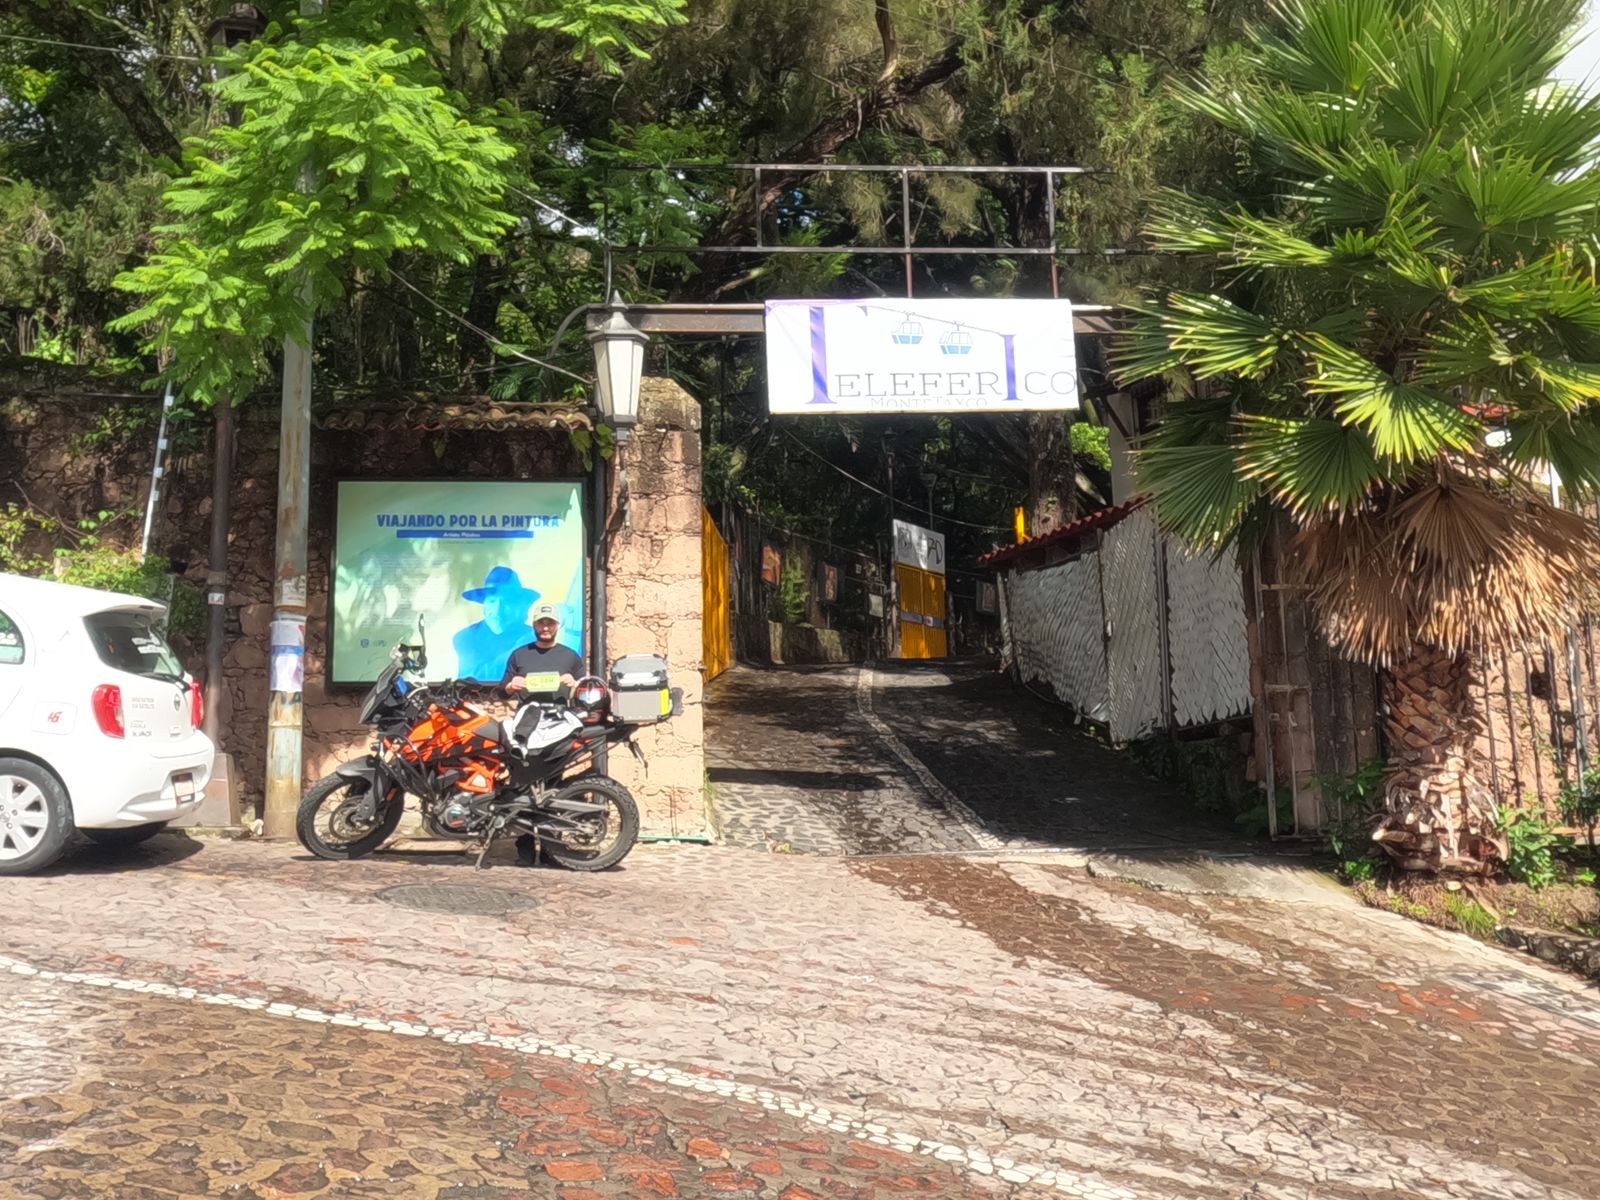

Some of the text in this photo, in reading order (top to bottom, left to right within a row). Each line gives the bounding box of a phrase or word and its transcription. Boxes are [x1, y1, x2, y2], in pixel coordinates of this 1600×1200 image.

[376, 514, 560, 528] VIAJANDO POR LA PINTURA
